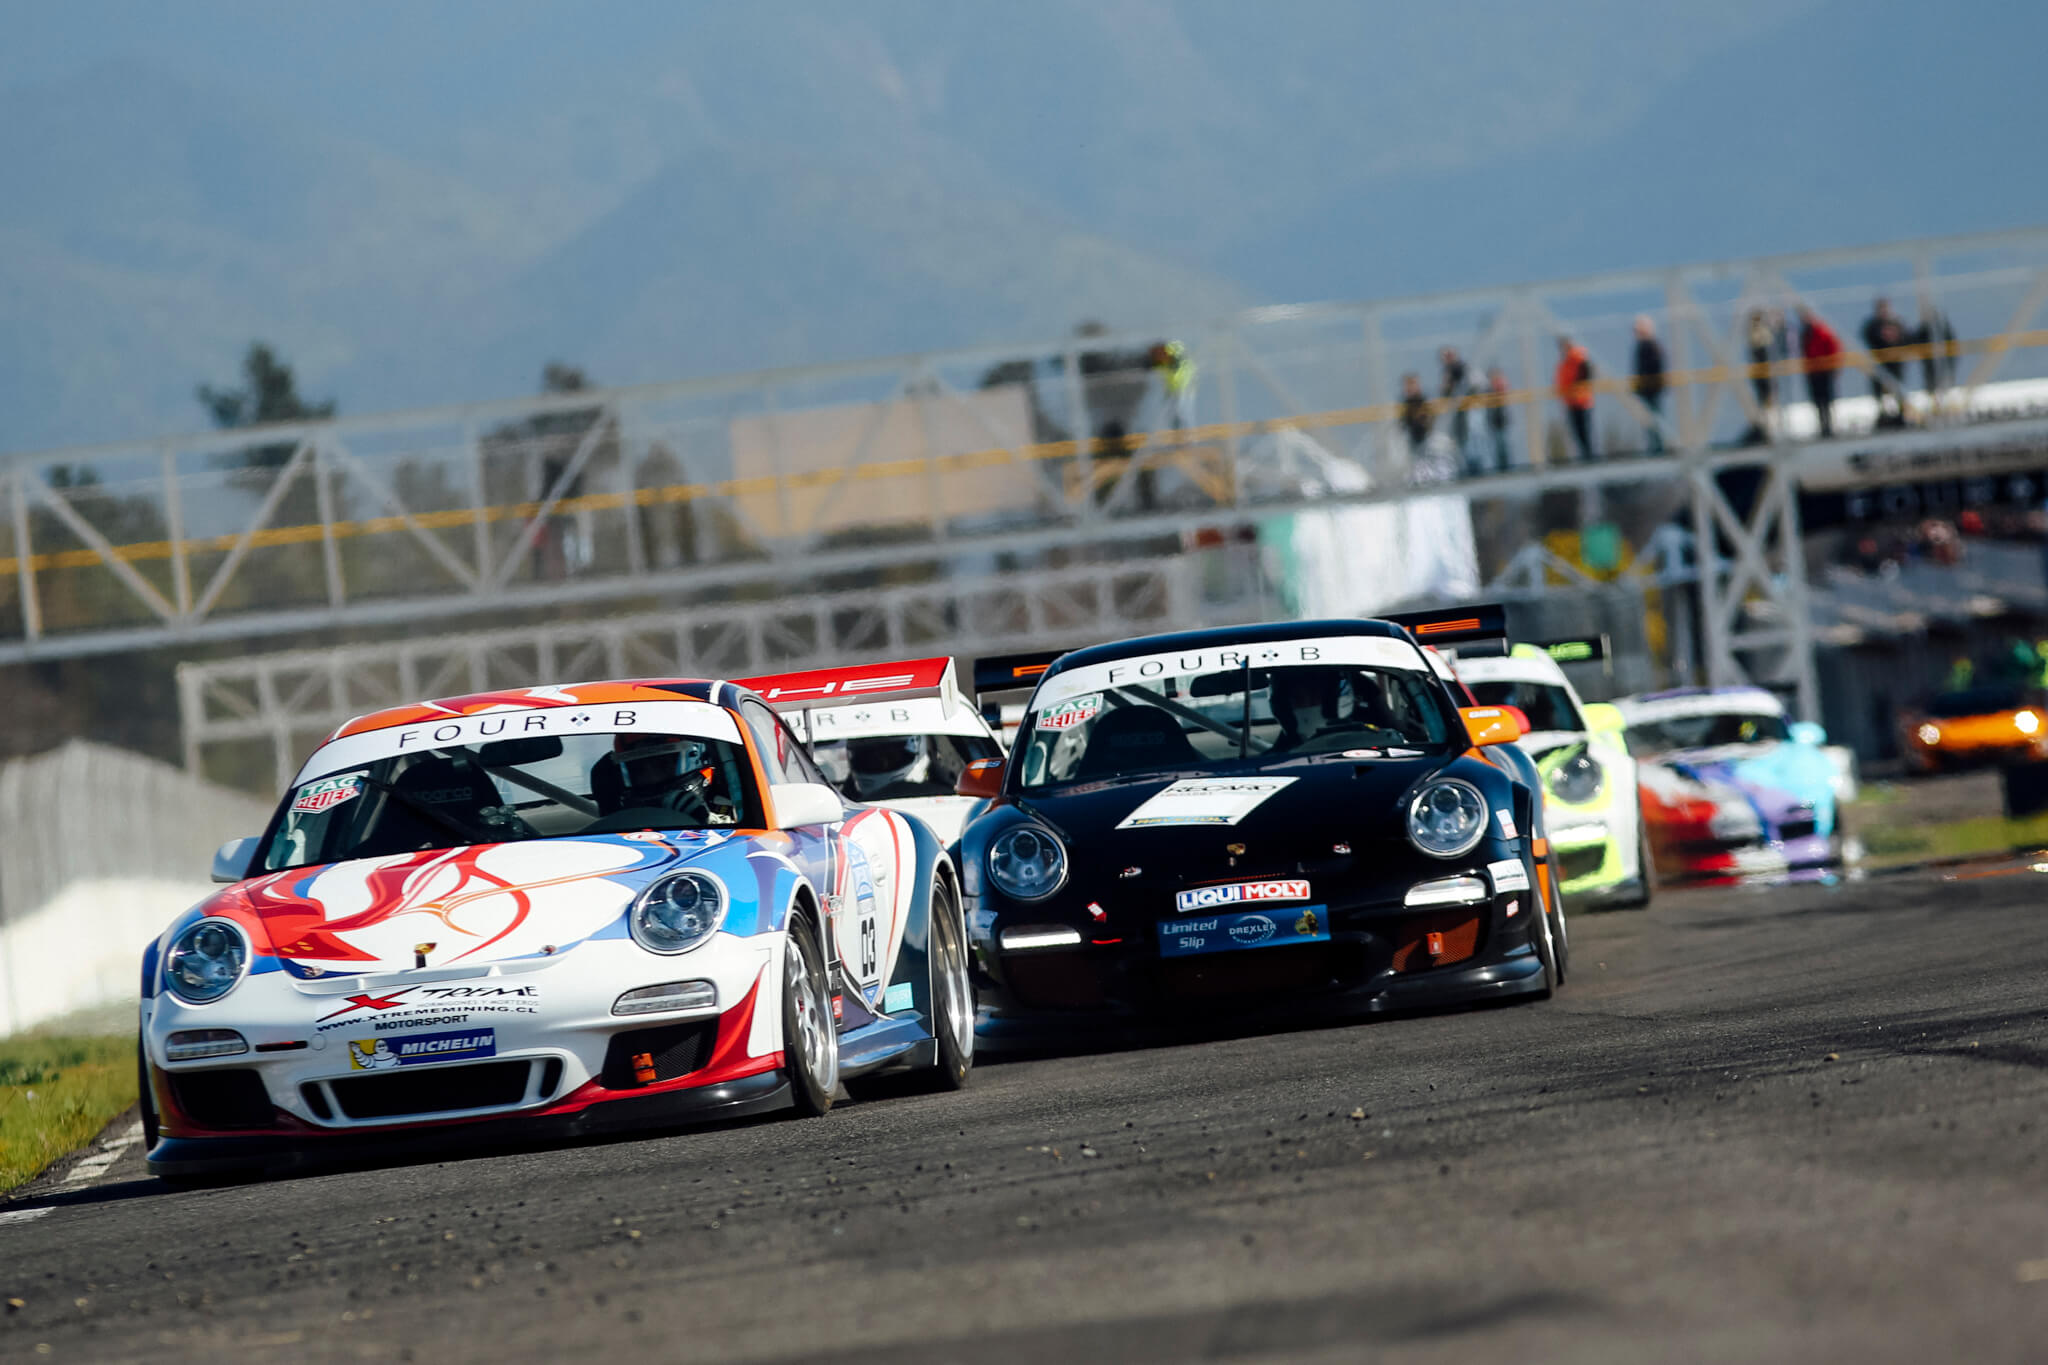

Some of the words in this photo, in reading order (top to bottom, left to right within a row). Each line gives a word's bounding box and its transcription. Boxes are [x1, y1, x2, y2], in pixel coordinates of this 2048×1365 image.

[1109, 651, 1242, 683] FOUR
[1300, 646, 1321, 661] B
[750, 674, 915, 699] HE
[891, 708, 911, 722] B
[1040, 707, 1097, 728] HEUER
[1042, 699, 1097, 719] TAG
[399, 714, 548, 748] FOUR
[613, 710, 637, 726] B
[302, 775, 358, 797] TAG
[296, 786, 357, 810] HEUER
[1180, 886, 1241, 909] LIQUI
[1245, 883, 1306, 898] MOLY
[1163, 919, 1218, 935] Limited
[1228, 923, 1277, 936] DREXLER
[1178, 936, 1205, 949] Slip
[375, 1014, 469, 1031] MOTORSPORT
[400, 1035, 493, 1055] MICHELIN
